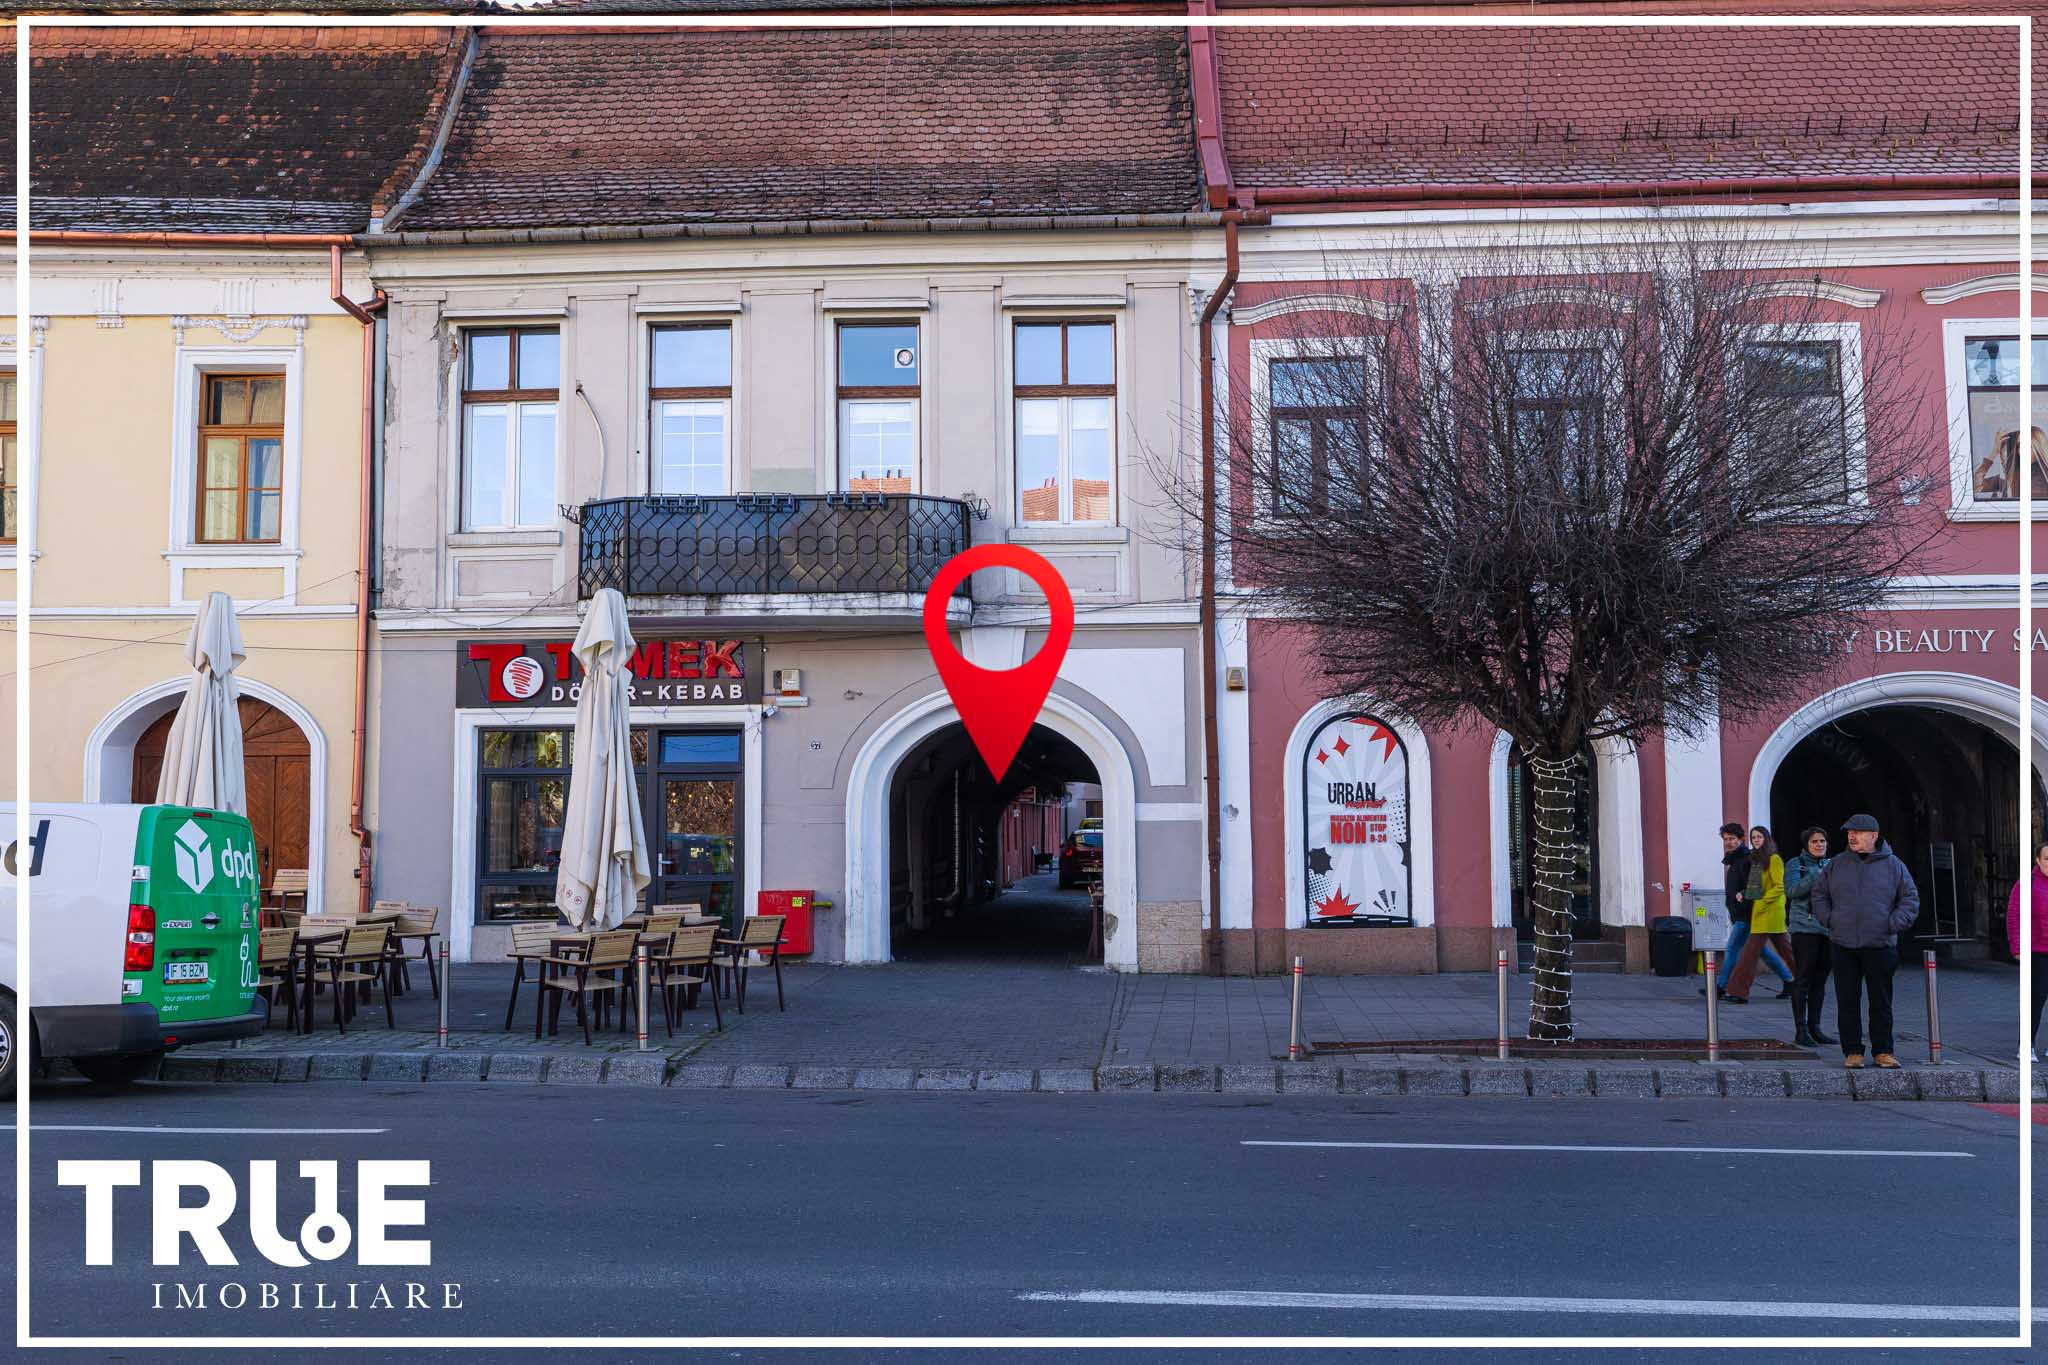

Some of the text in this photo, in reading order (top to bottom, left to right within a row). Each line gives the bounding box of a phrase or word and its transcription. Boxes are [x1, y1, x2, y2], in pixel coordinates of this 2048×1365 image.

[1874, 629, 1995, 653] BEAUTY
[546, 640, 743, 680] TMEK
[552, 683, 743, 701] DÖR-KEBAB
[1328, 782, 1376, 804] URBAN
[1330, 822, 1387, 844] NON STOP
[221, 838, 254, 889] dpd
[180, 965, 187, 977] 15
[189, 964, 205, 977] BZM
